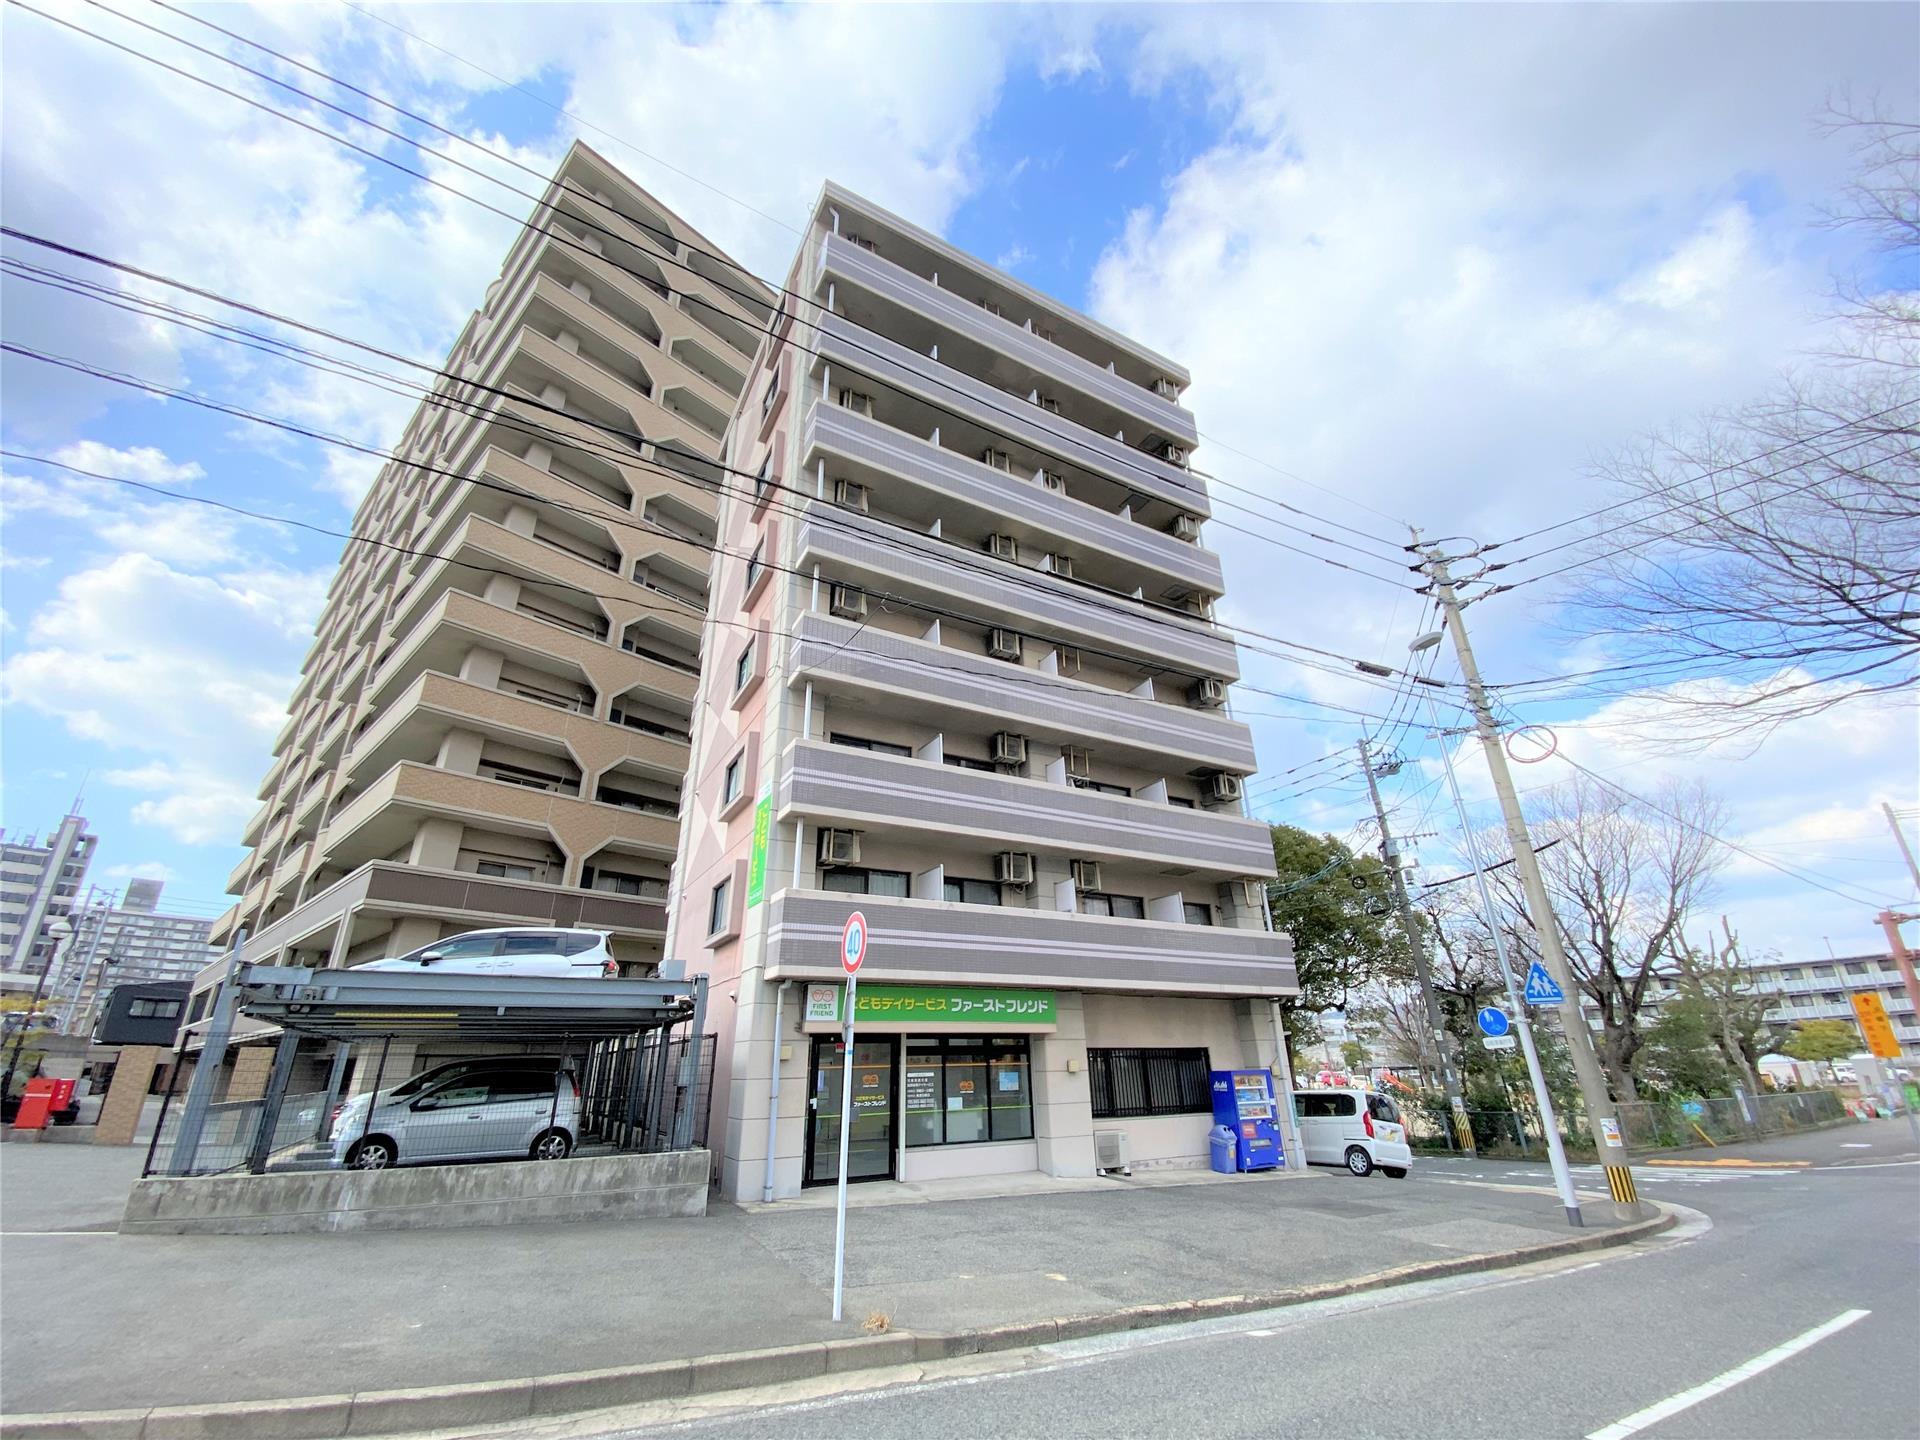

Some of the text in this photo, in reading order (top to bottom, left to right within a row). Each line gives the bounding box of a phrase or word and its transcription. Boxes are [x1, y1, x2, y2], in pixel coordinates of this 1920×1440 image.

[847, 928, 861, 956] 40
[951, 998, 1049, 1014] ファーストフレンド
